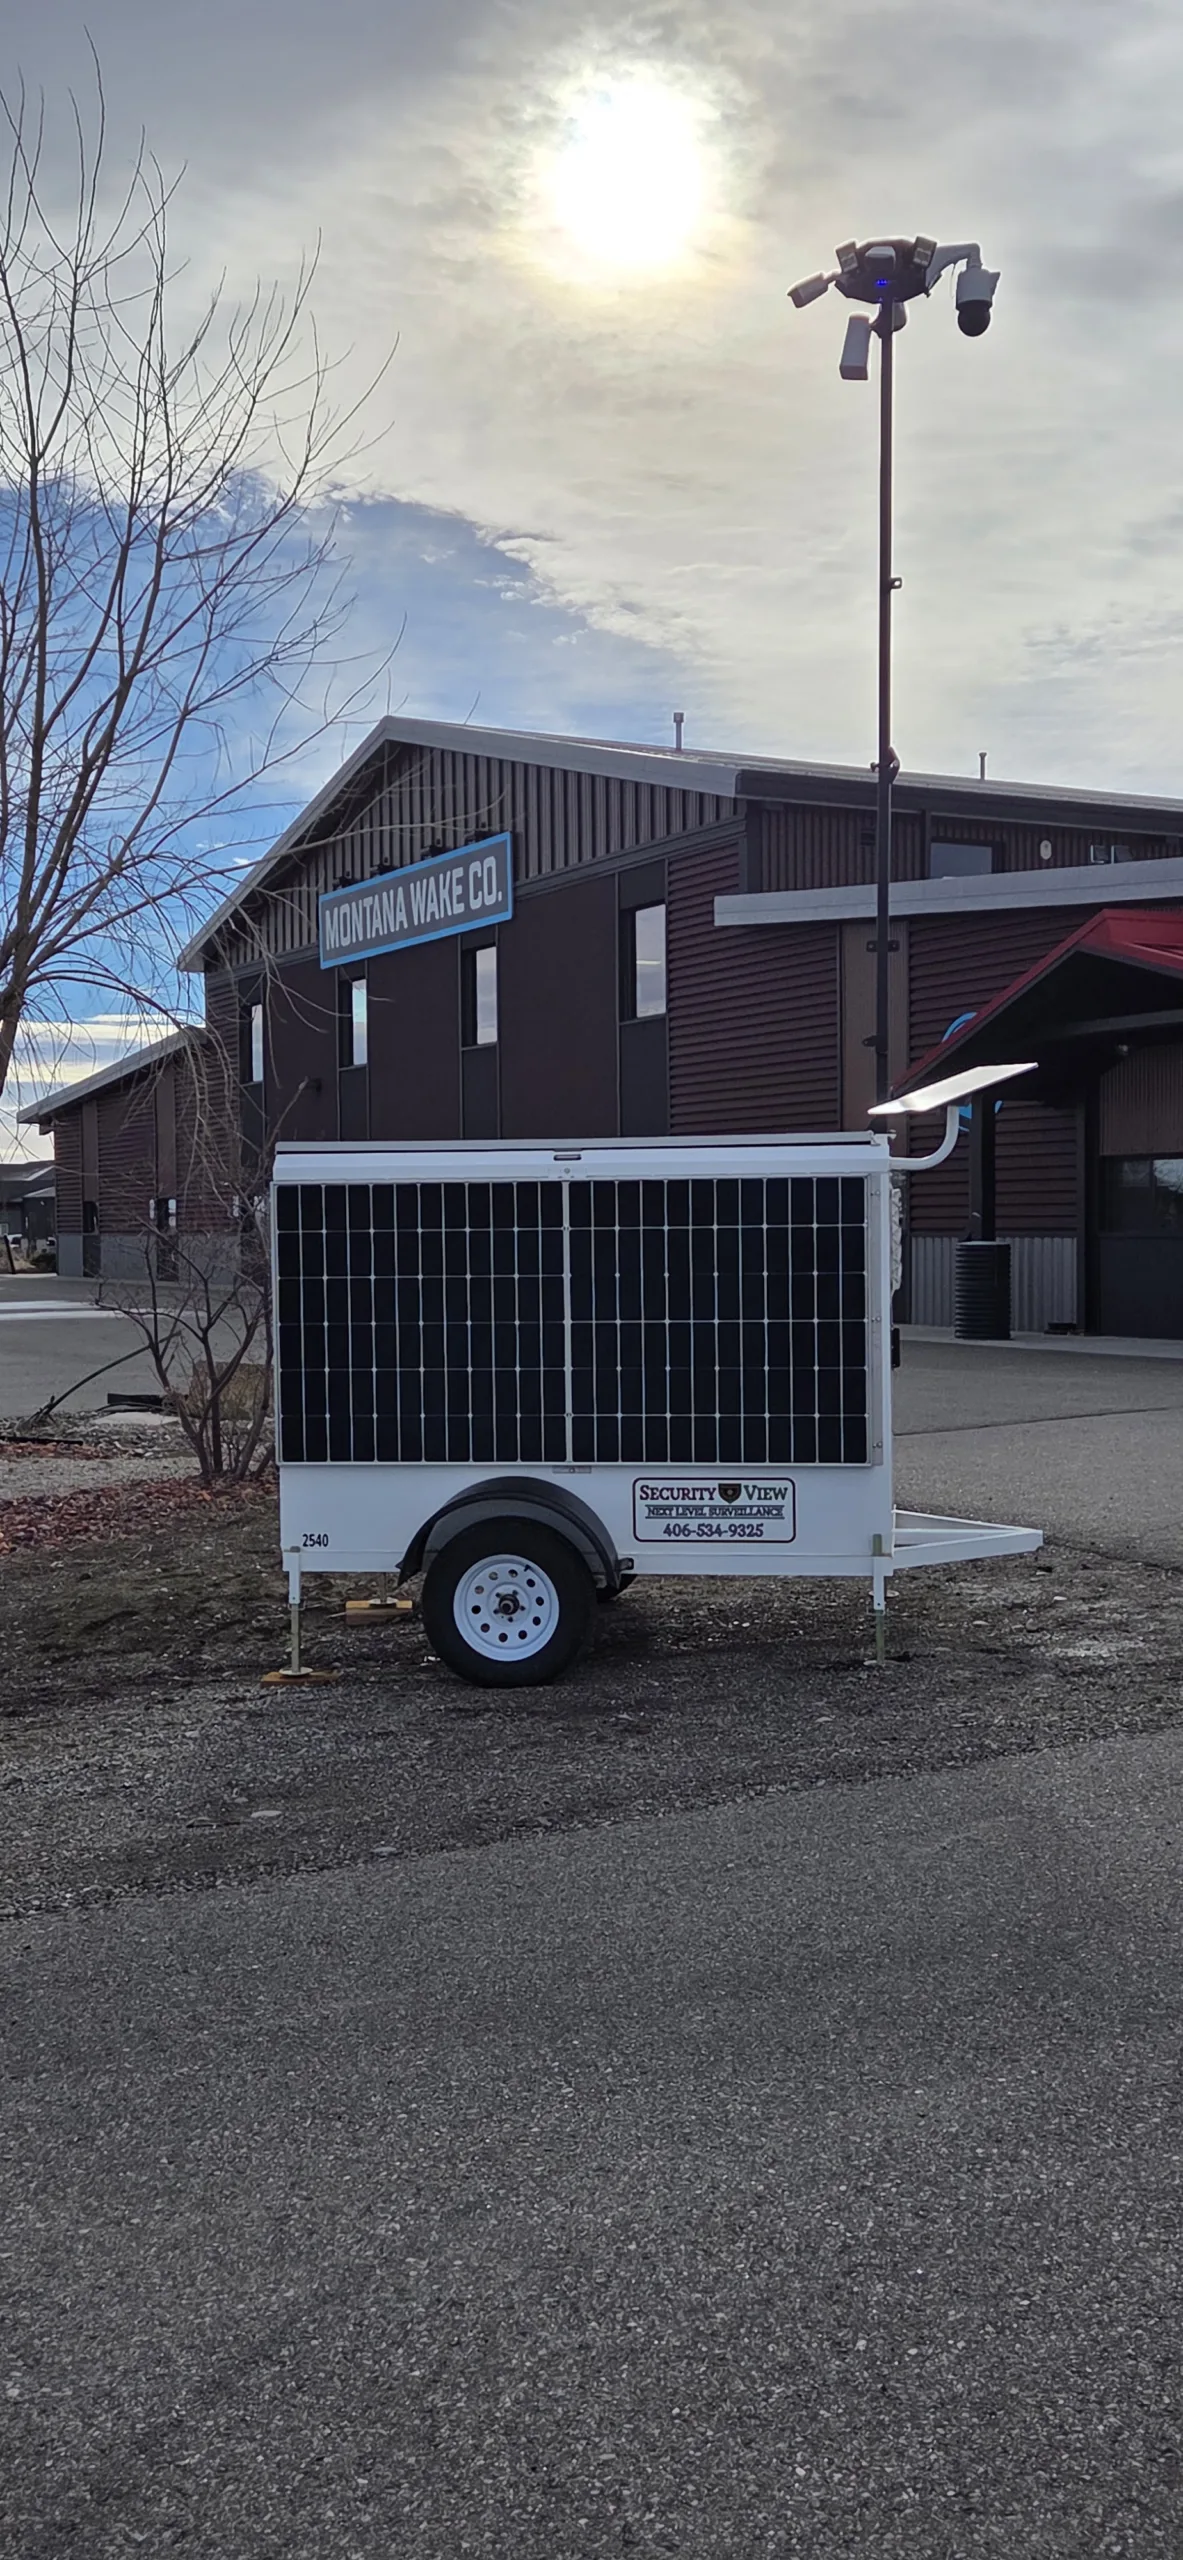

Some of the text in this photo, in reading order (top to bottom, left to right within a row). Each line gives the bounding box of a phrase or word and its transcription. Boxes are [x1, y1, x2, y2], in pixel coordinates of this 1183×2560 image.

[325, 855, 503, 951] MONTANA WAKE CO.
[639, 1484, 788, 1501] SECURITY VIEW
[647, 1506, 783, 1517] NEXT LEVEL SURVEILLANCE
[662, 1522, 764, 1538] 406-534-9325
[302, 1533, 329, 1548] 2540
